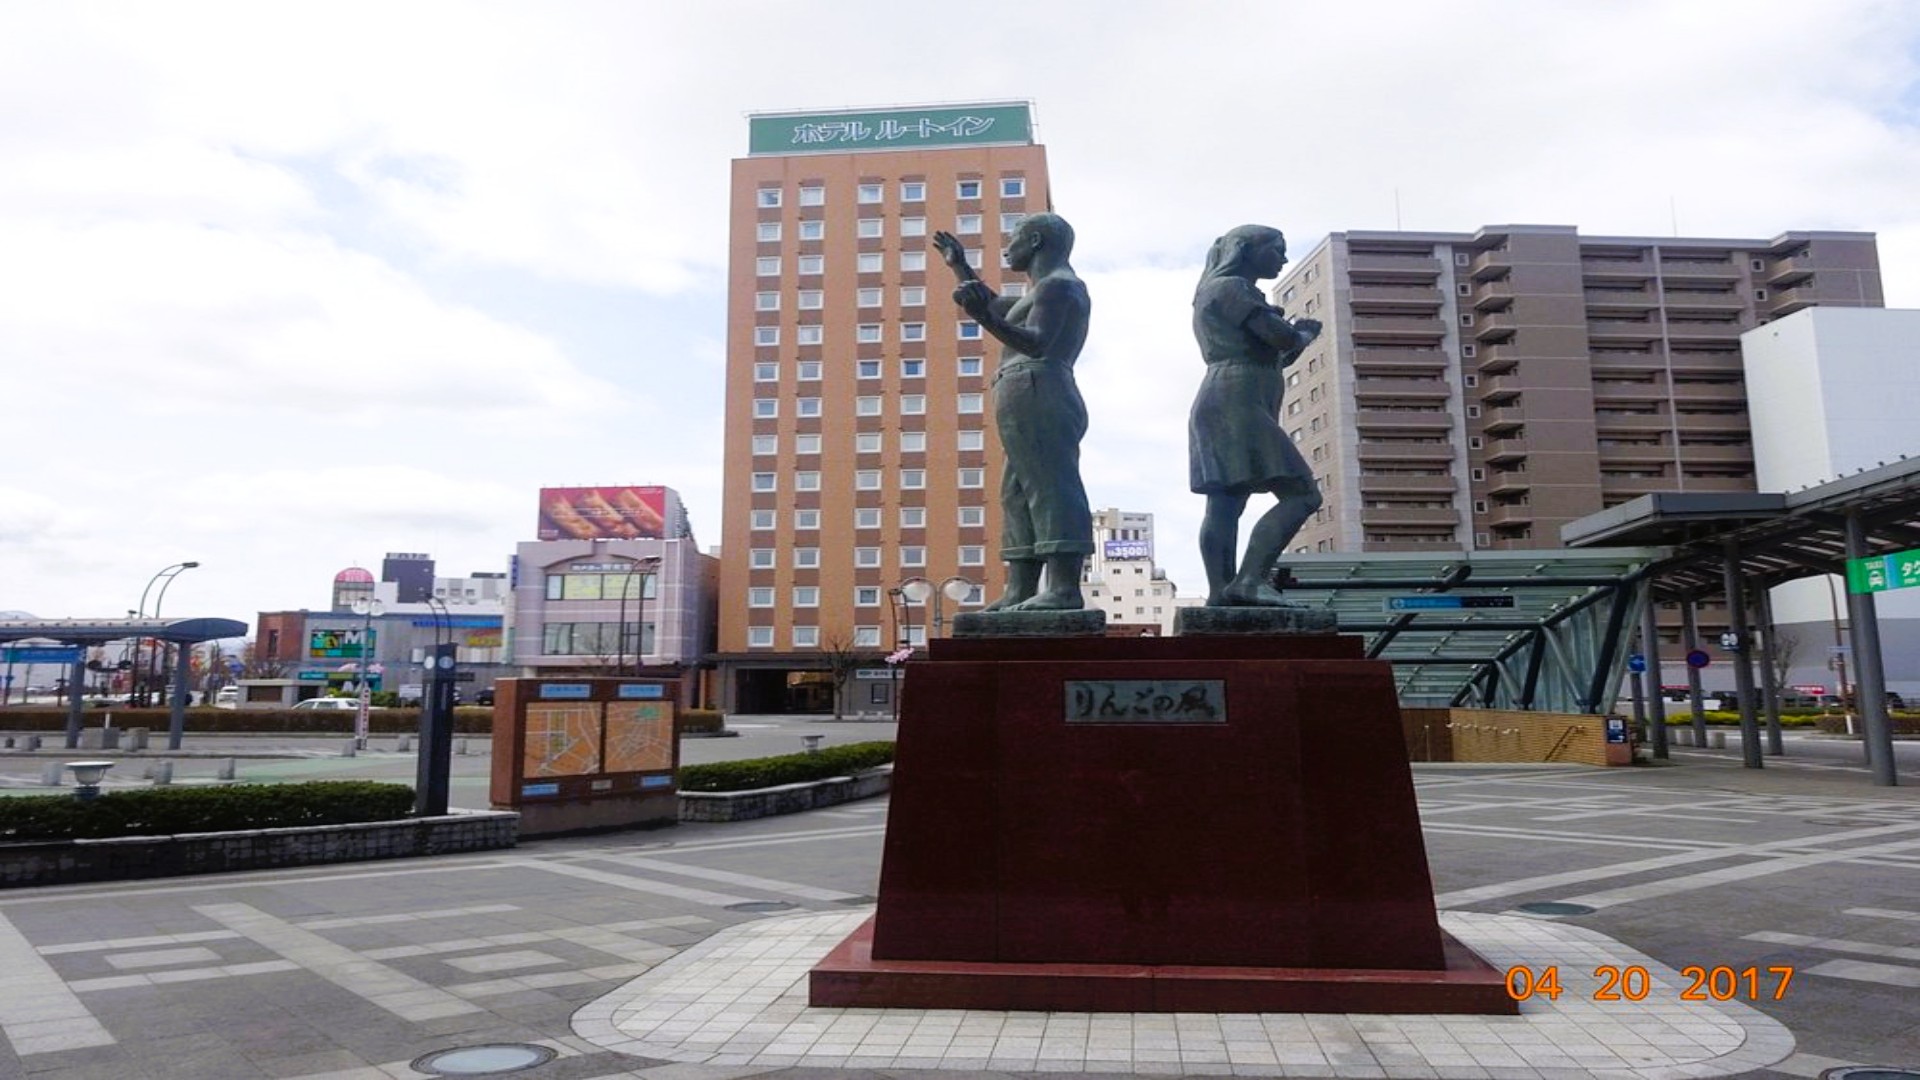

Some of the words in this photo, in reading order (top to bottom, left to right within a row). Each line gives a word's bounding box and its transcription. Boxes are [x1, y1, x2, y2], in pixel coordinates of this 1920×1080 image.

[791, 121, 871, 144] ホテル
[875, 115, 995, 141] ルートイン
